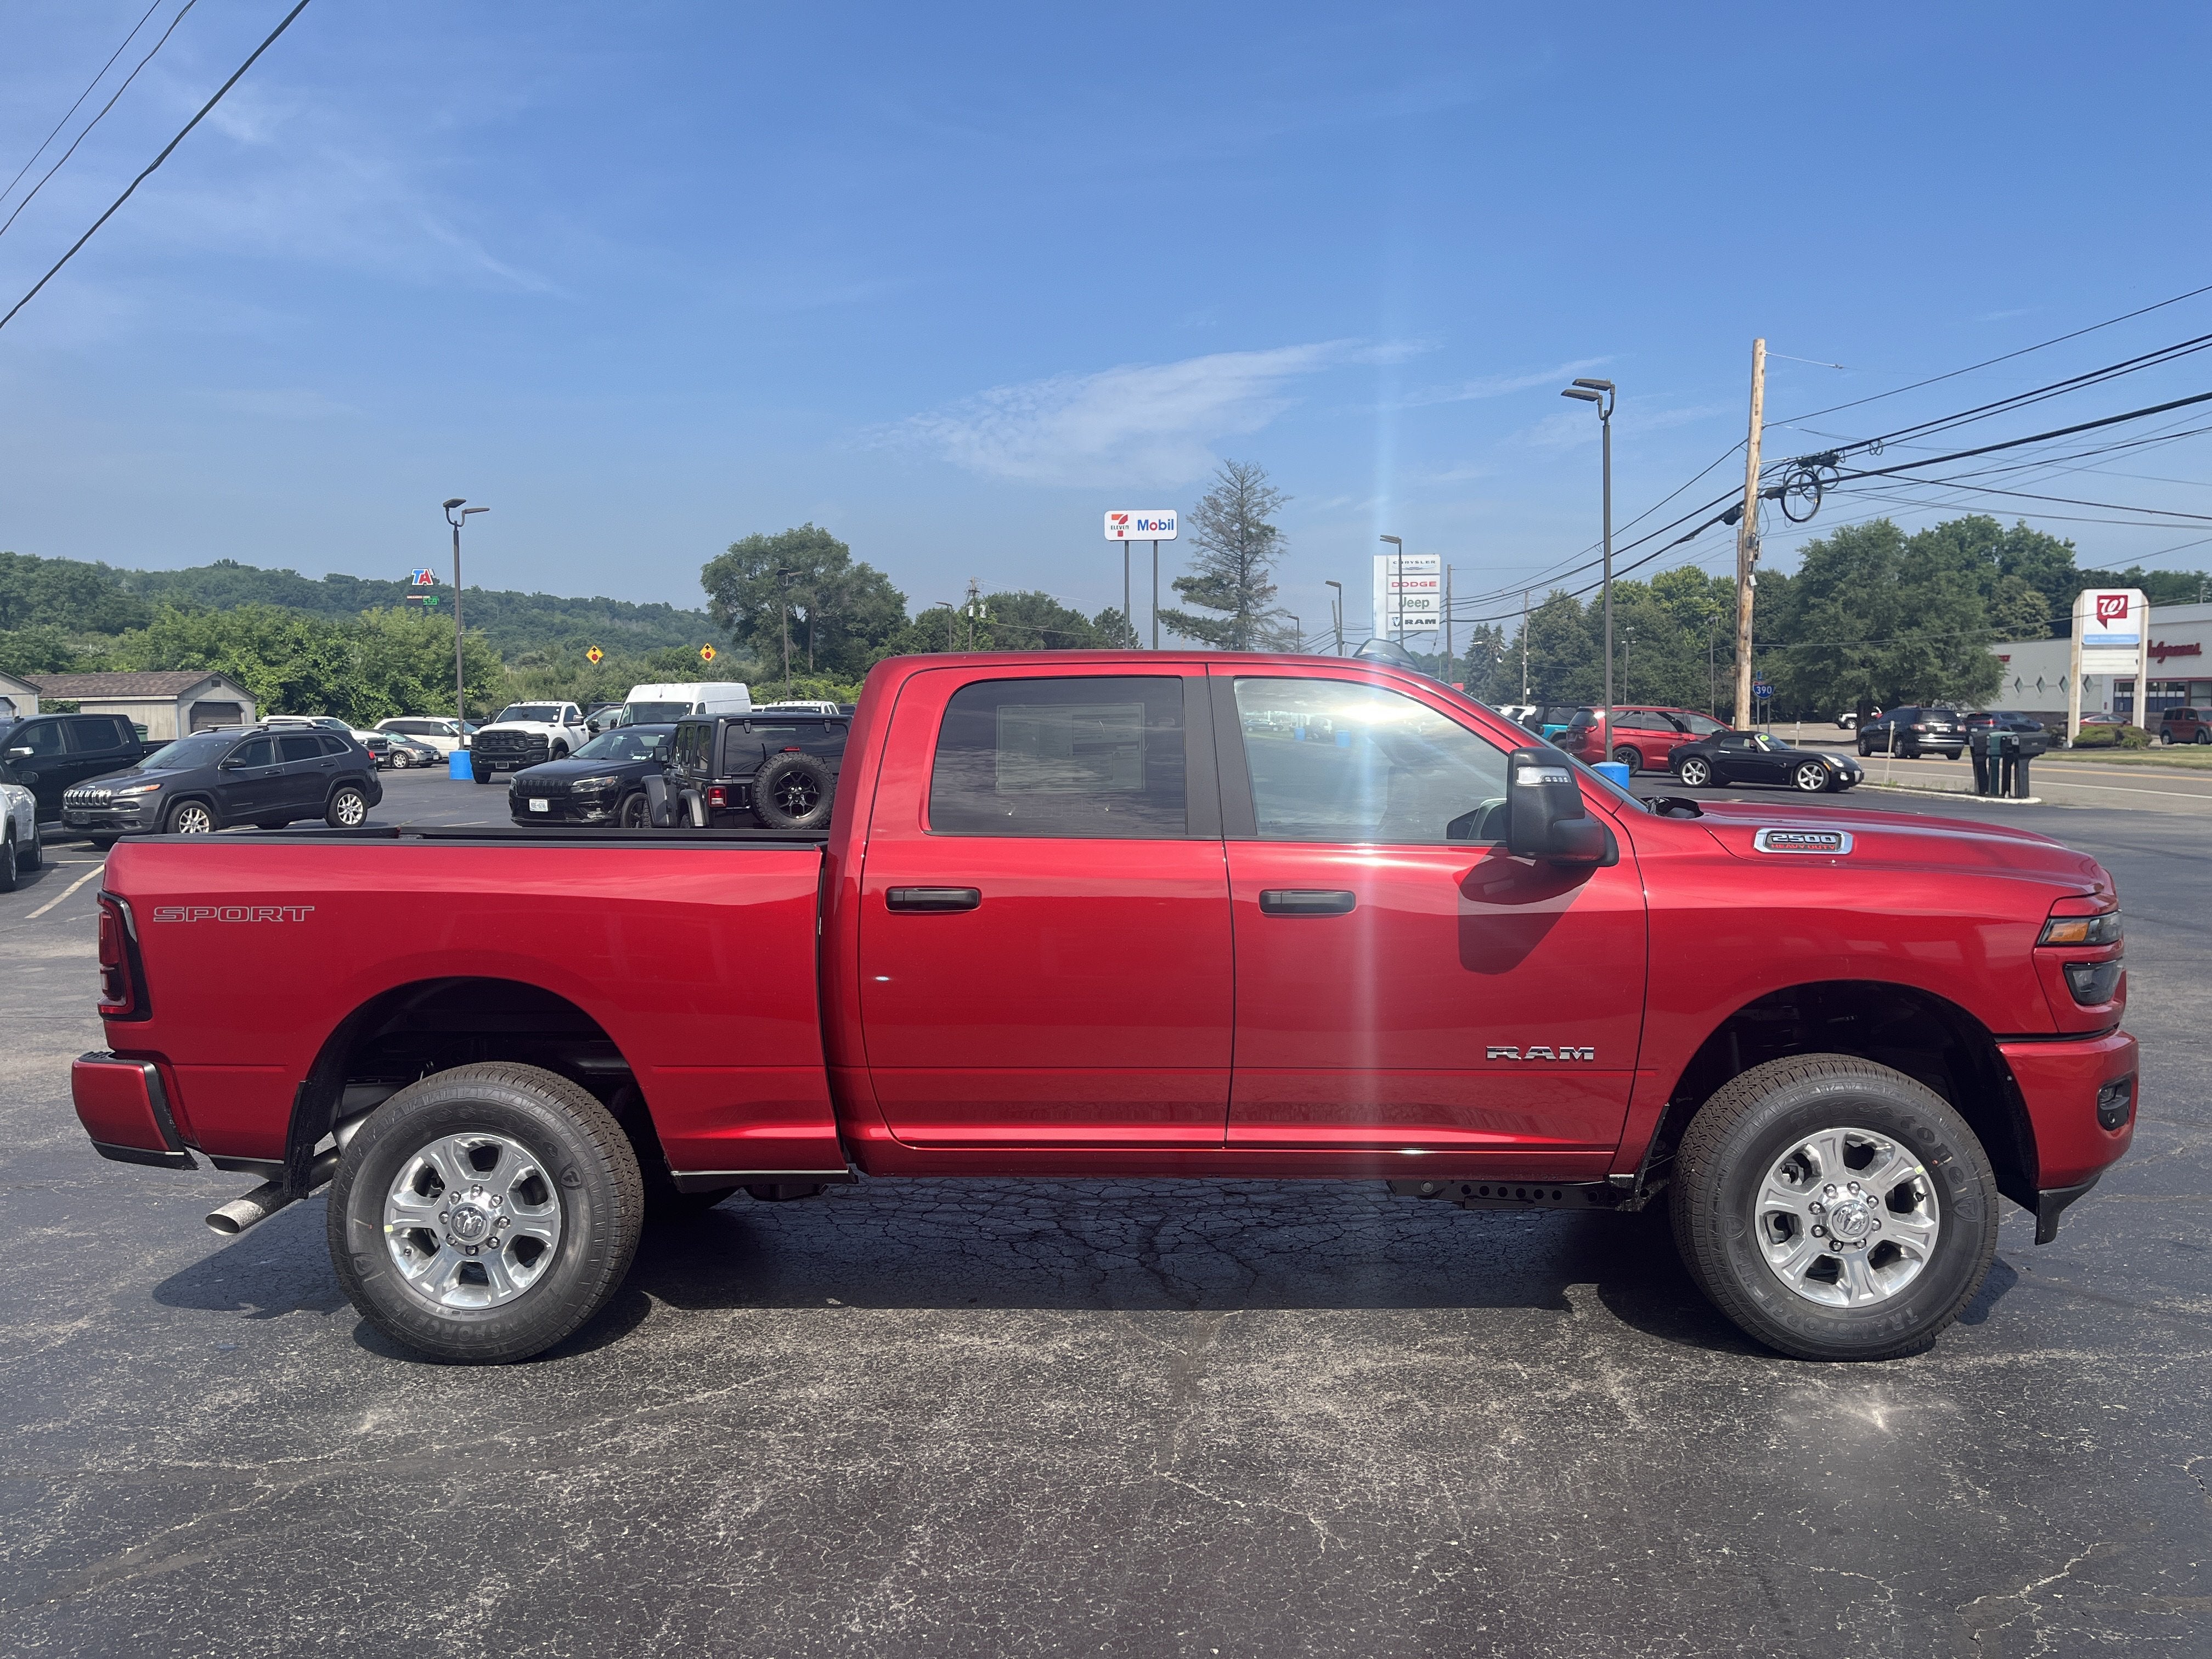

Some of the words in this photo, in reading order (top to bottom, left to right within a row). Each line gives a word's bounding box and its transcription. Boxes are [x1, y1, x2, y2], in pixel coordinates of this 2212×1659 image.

[1137, 518, 1174, 531] Mobil
[412, 569, 433, 585] TA
[1399, 597, 1430, 610] Jeep
[1756, 686, 1773, 695] 390
[1771, 834, 1837, 844] 2500
[153, 906, 315, 922] SPORT
[1486, 1045, 1595, 1060] RAM
[1759, 1293, 1919, 1340] TRANSFORCE
